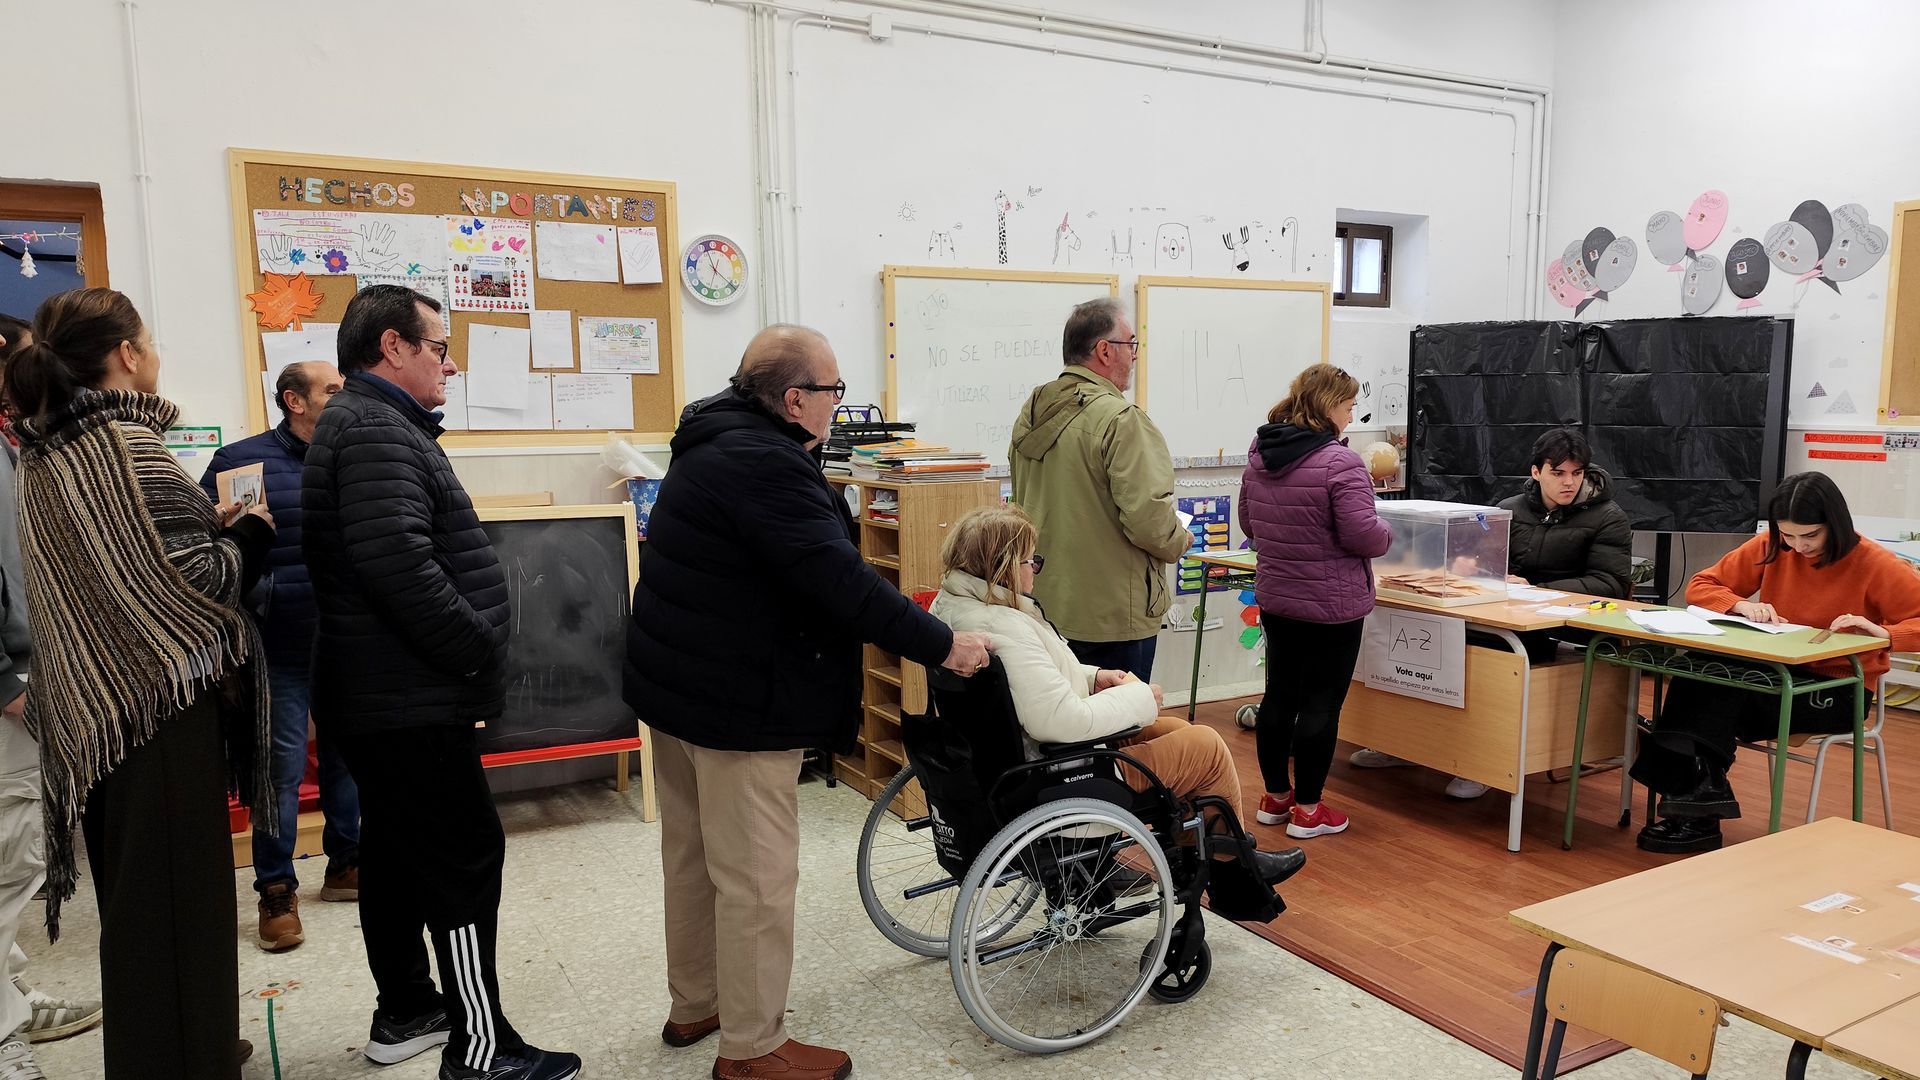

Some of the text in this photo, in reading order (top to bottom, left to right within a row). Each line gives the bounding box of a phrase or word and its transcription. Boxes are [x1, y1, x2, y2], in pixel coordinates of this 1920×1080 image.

[279, 175, 416, 207] HECHOS
[928, 338, 1058, 368] NO SE PUEDEN
[936, 384, 990, 406] UTILIZAR
[1395, 666, 1413, 677] Vota
[1381, 676, 1400, 684] apellido
[1400, 680, 1421, 689] empieza
[1445, 688, 1459, 696] letras
